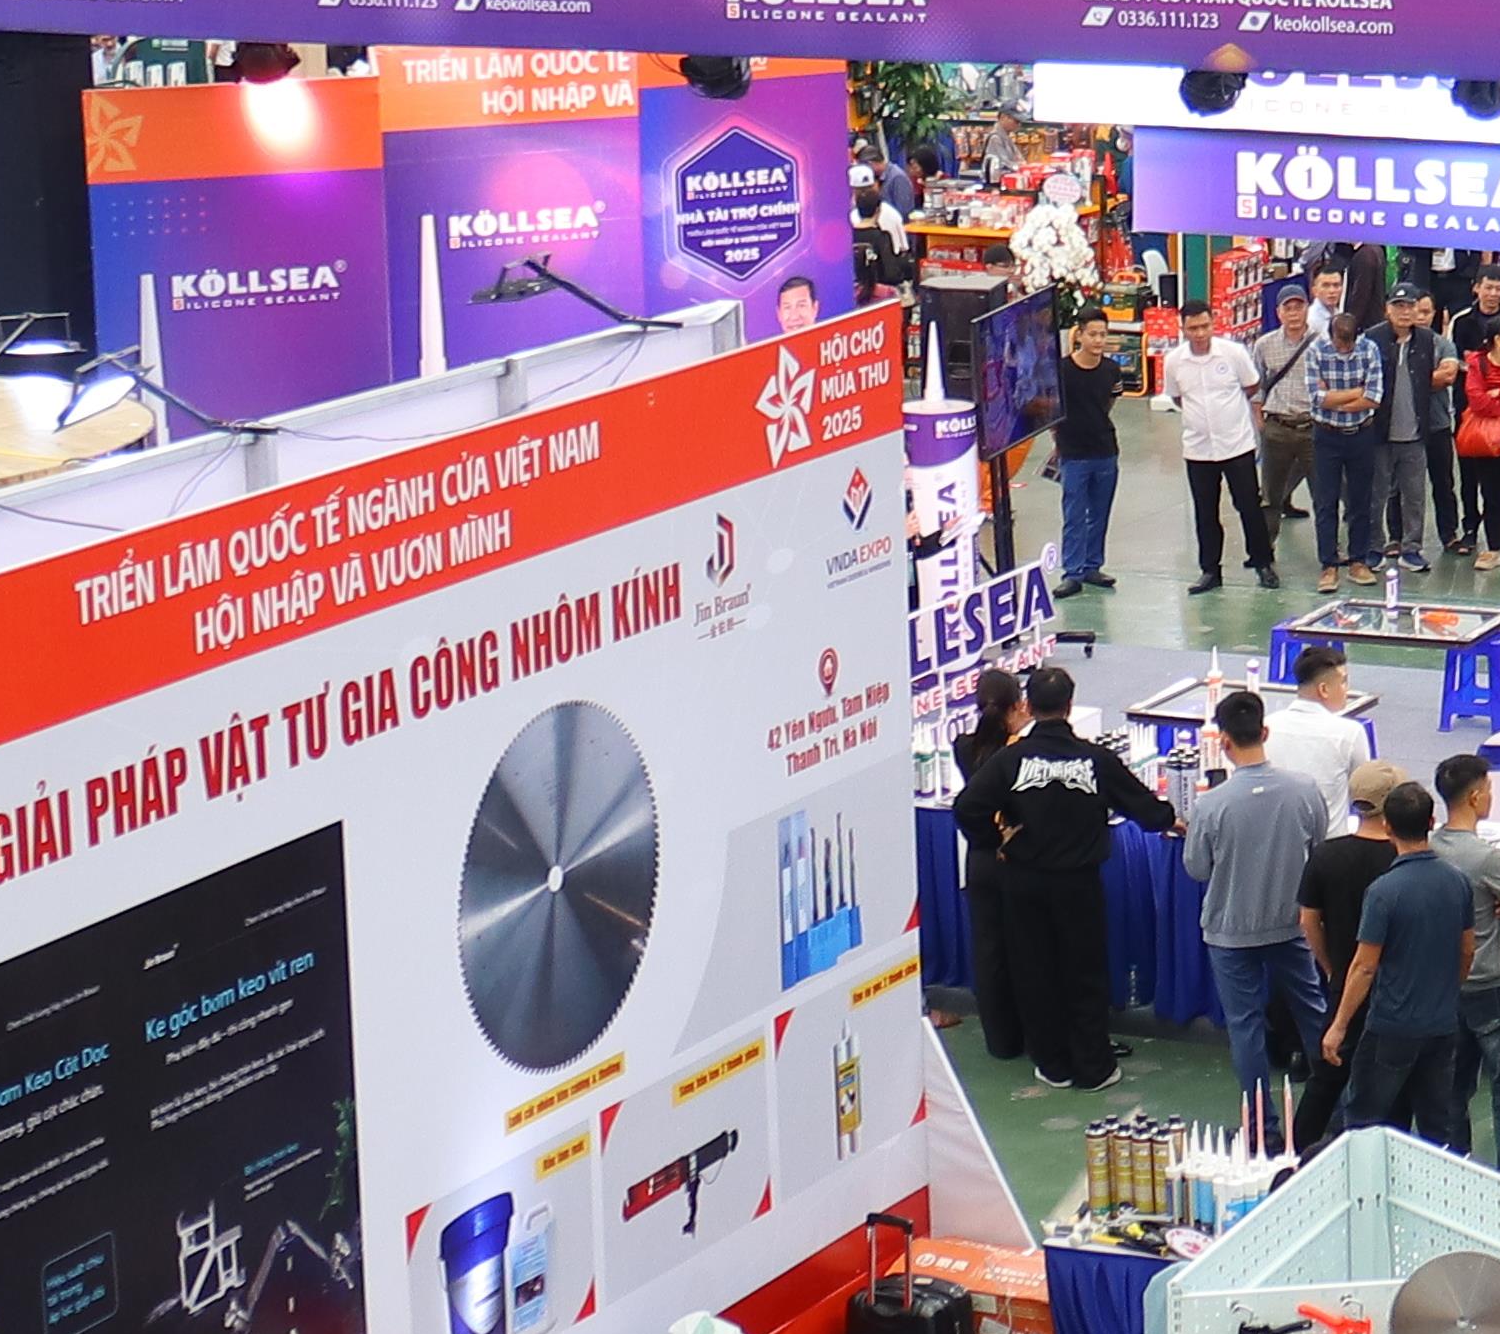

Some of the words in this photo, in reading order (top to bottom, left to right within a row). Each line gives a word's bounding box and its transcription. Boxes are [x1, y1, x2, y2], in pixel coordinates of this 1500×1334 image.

[726, 2, 826, 21] SILICONE
[835, 8, 928, 24] SEALANT
[1117, 9, 1220, 30] 0336.111.123
[1273, 13, 1394, 36] keokollsea.com
[481, 86, 527, 116] HỘI
[530, 83, 598, 114] NHẬP
[601, 75, 635, 106] VÀ
[685, 168, 788, 193] KÖLLSEA
[448, 205, 600, 238] KÖLLSEA
[677, 209, 706, 225] NHÀ
[706, 206, 729, 223] TÀI
[730, 204, 758, 221] TRỢ
[759, 200, 801, 217] CHÍNH
[1235, 194, 1386, 226] SILICONE
[724, 247, 760, 263] 2025
[170, 265, 339, 299] KÖLLSEA
[819, 331, 849, 368] HỘI
[850, 320, 885, 355] CHỢ
[820, 369, 859, 405] MÙA
[861, 358, 891, 386] THU
[821, 404, 863, 442] 2025
[74, 547, 156, 625] TRIỂN
[163, 537, 221, 598] LÃM
[228, 504, 307, 579] QUỐC
[311, 485, 343, 548] TẾ
[347, 468, 436, 535] NGÀNH
[441, 438, 491, 505] CỬA
[497, 432, 544, 489] VIỆT
[548, 420, 601, 473] NAM
[193, 592, 246, 656] HỘI
[251, 568, 326, 636] NHẬP
[331, 551, 368, 602] VÀ
[372, 532, 444, 588] VƯƠN
[450, 509, 511, 565] MÌNH
[693, 601, 712, 627] Jin
[713, 585, 750, 617] Braun
[85, 744, 186, 849] PHÁP
[199, 711, 272, 803] VẬT
[280, 682, 331, 769] TƯ
[340, 666, 400, 746] GIA
[409, 629, 500, 720] CÔNG
[510, 590, 603, 681] NHÔM
[611, 562, 683, 645] KÍNH
[766, 727, 782, 752] 42
[783, 713, 806, 745] Yên
[841, 693, 863, 719] Tam
[864, 678, 890, 712] Hiệp
[785, 739, 822, 777] Thanh
[843, 727, 859, 751] Hà
[859, 715, 878, 747] Nội
